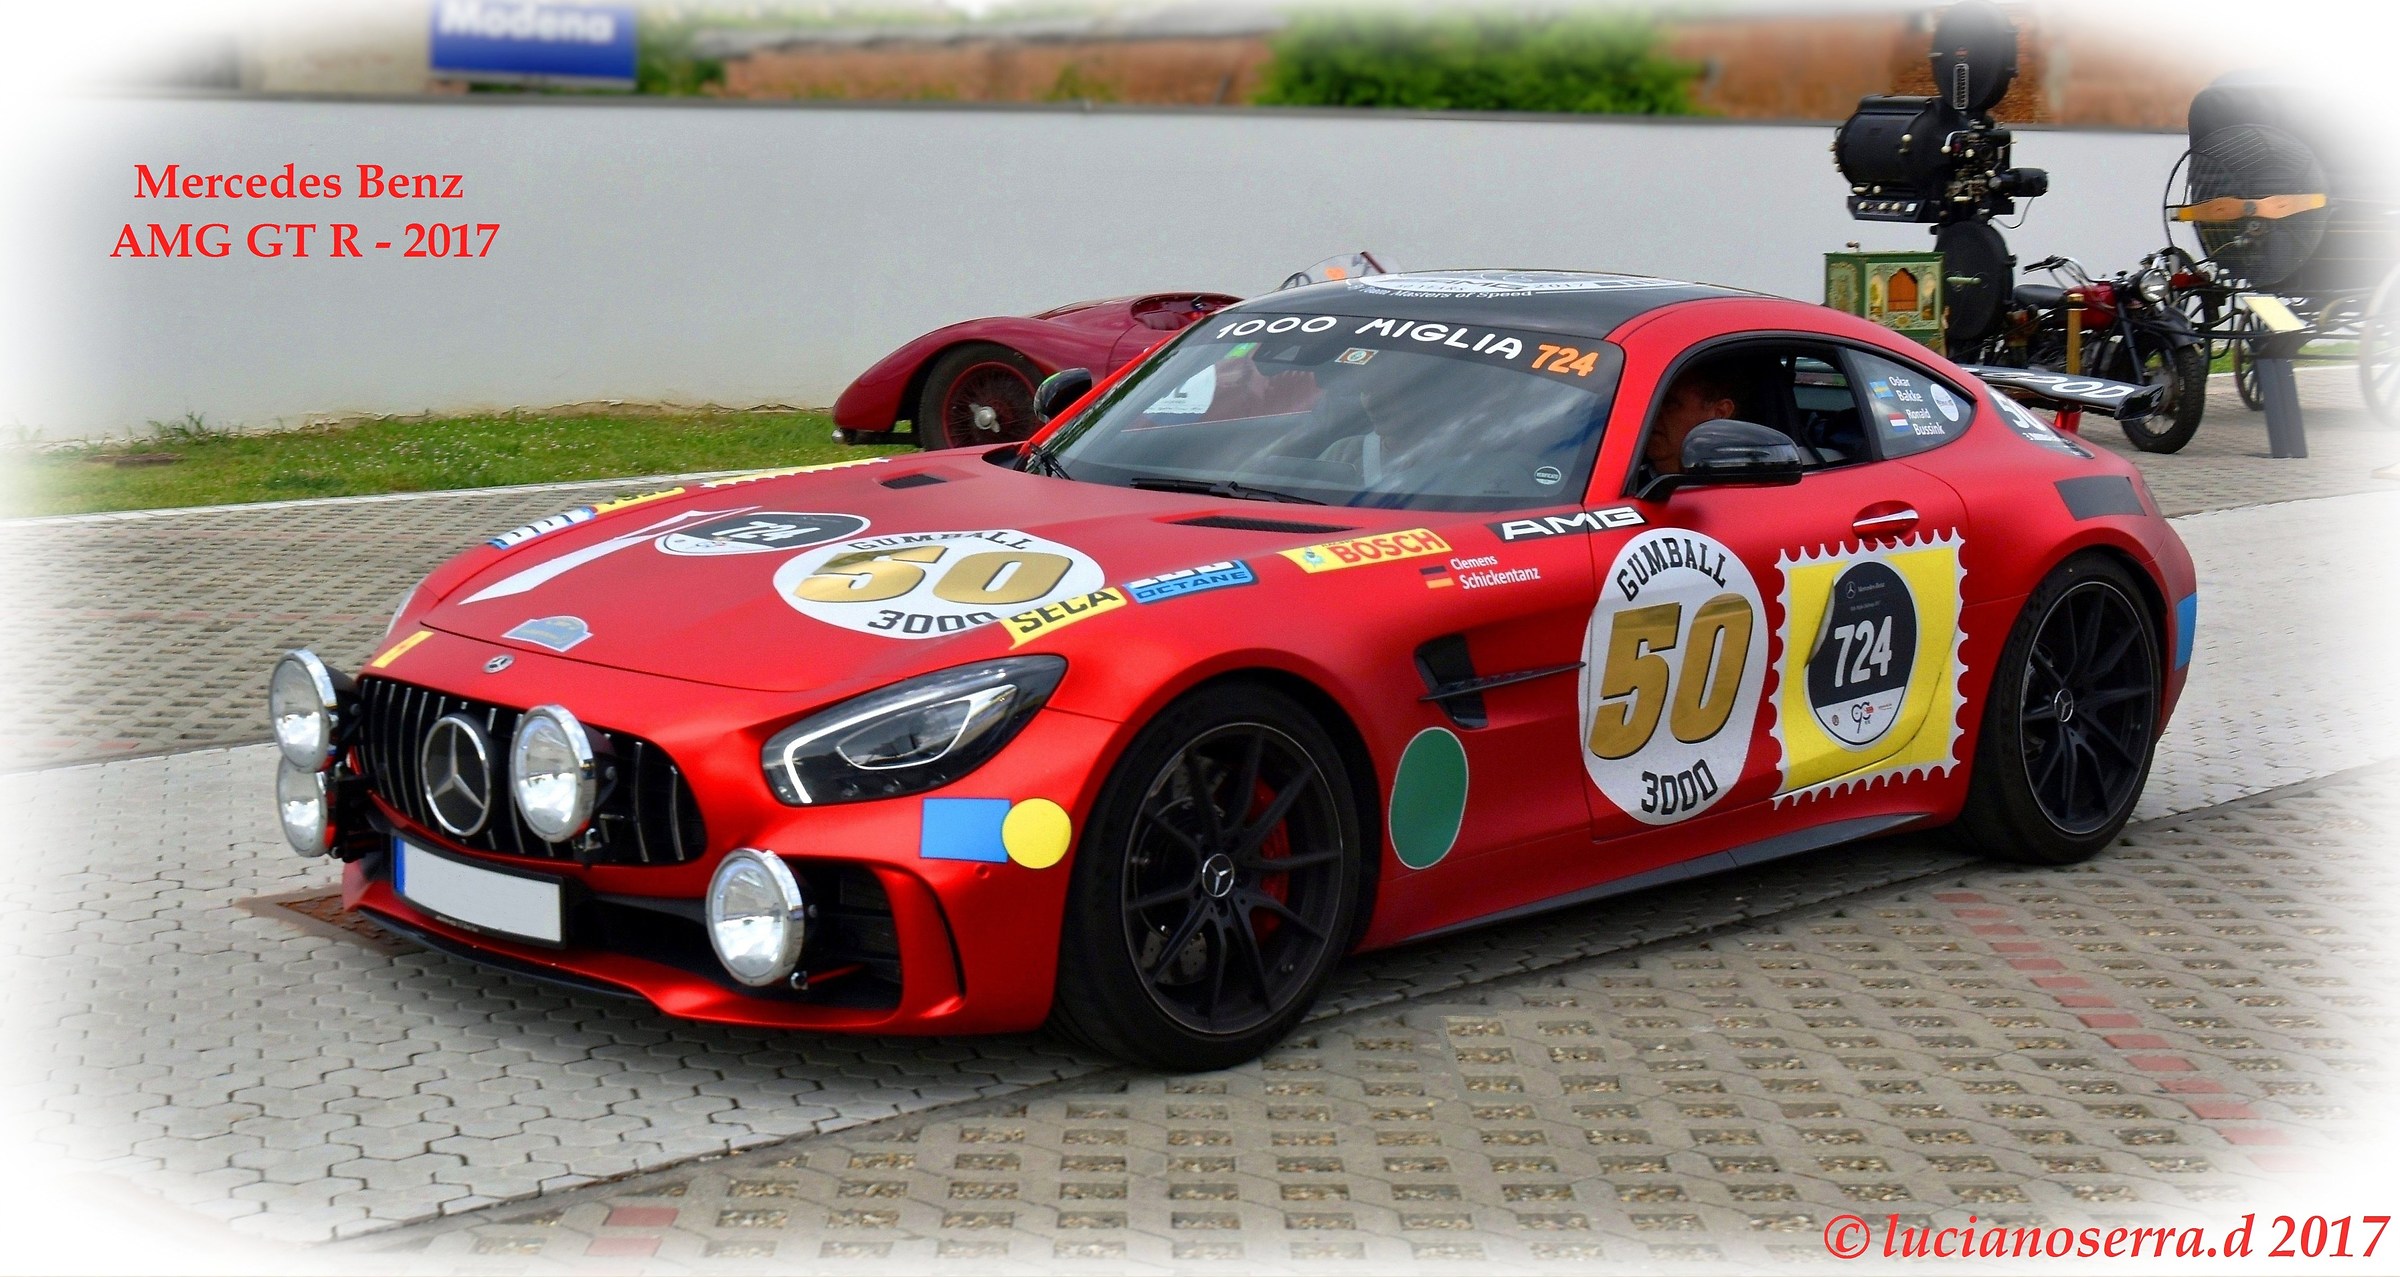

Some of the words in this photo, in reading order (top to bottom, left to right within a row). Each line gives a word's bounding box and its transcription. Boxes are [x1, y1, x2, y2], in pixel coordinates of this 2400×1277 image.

[1216, 315, 1337, 339] 1000
[1354, 317, 1524, 361] MIGLIA
[1531, 343, 1599, 377] 724
[1888, 376, 1911, 388] Oskar
[1895, 389, 1924, 402] Bakke
[1905, 408, 1932, 420] Ronald
[1912, 422, 1946, 436] Bussink
[711, 520, 821, 542] 724
[1502, 506, 1645, 540] AMG
[1326, 531, 1446, 564] BOSCH
[1450, 554, 1498, 570] Clemens
[792, 545, 1074, 605] 50
[1136, 571, 1248, 600] OCTANE
[1458, 567, 1541, 590] Schickentanz
[1616, 537, 1727, 602] GUMBALL
[1010, 590, 1119, 633] SECA
[1834, 615, 1892, 688] 724
[1588, 592, 1754, 760] 50
[1641, 759, 1718, 816] 3000
